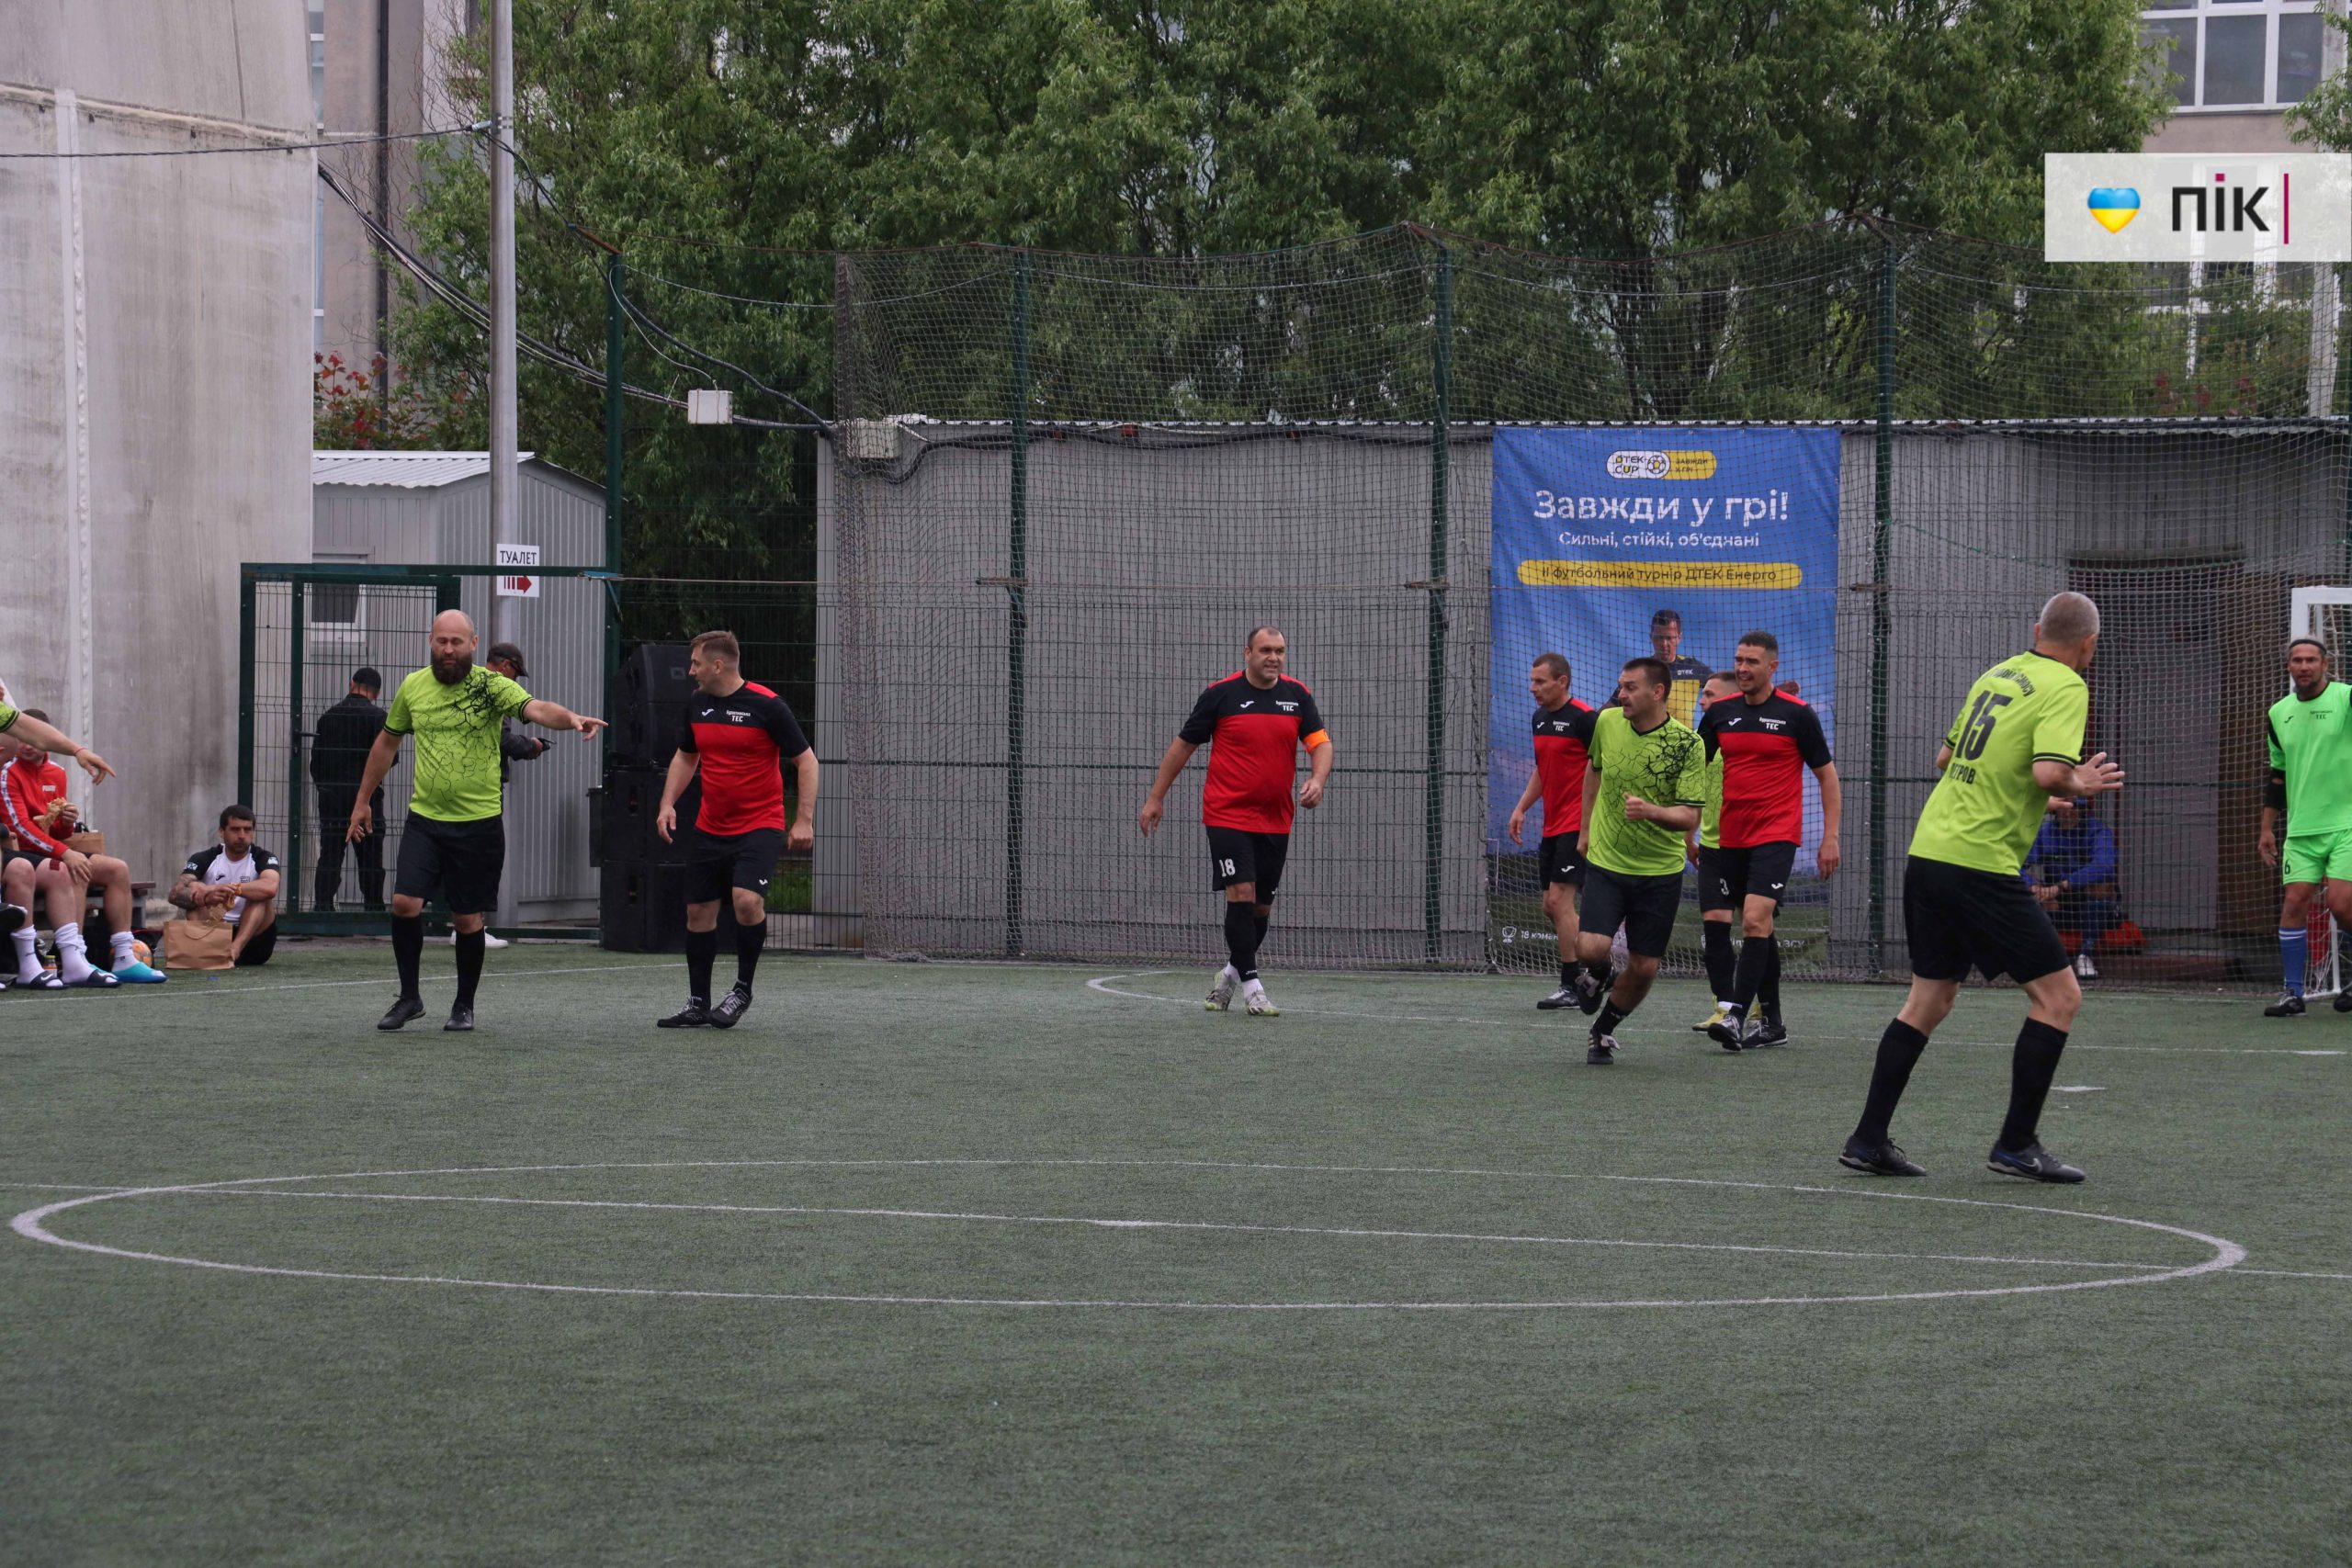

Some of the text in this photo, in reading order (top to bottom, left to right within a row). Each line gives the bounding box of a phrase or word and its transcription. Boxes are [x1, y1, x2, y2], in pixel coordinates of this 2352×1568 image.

[1614, 465, 1639, 474] CUP
[1533, 489, 1789, 527] Завжди у грі!
[1558, 531, 1619, 548] Сильні,
[1623, 531, 1675, 548] стійкі,
[499, 550, 537, 565] ТУАЛЕТ
[1553, 566, 1634, 581] футбольний
[1637, 567, 1682, 581] турнір
[1685, 568, 1723, 581] ДТЕК
[1726, 569, 1777, 582] Енерго
[1955, 690, 2014, 761] 15
[1218, 858, 1236, 877] 18
